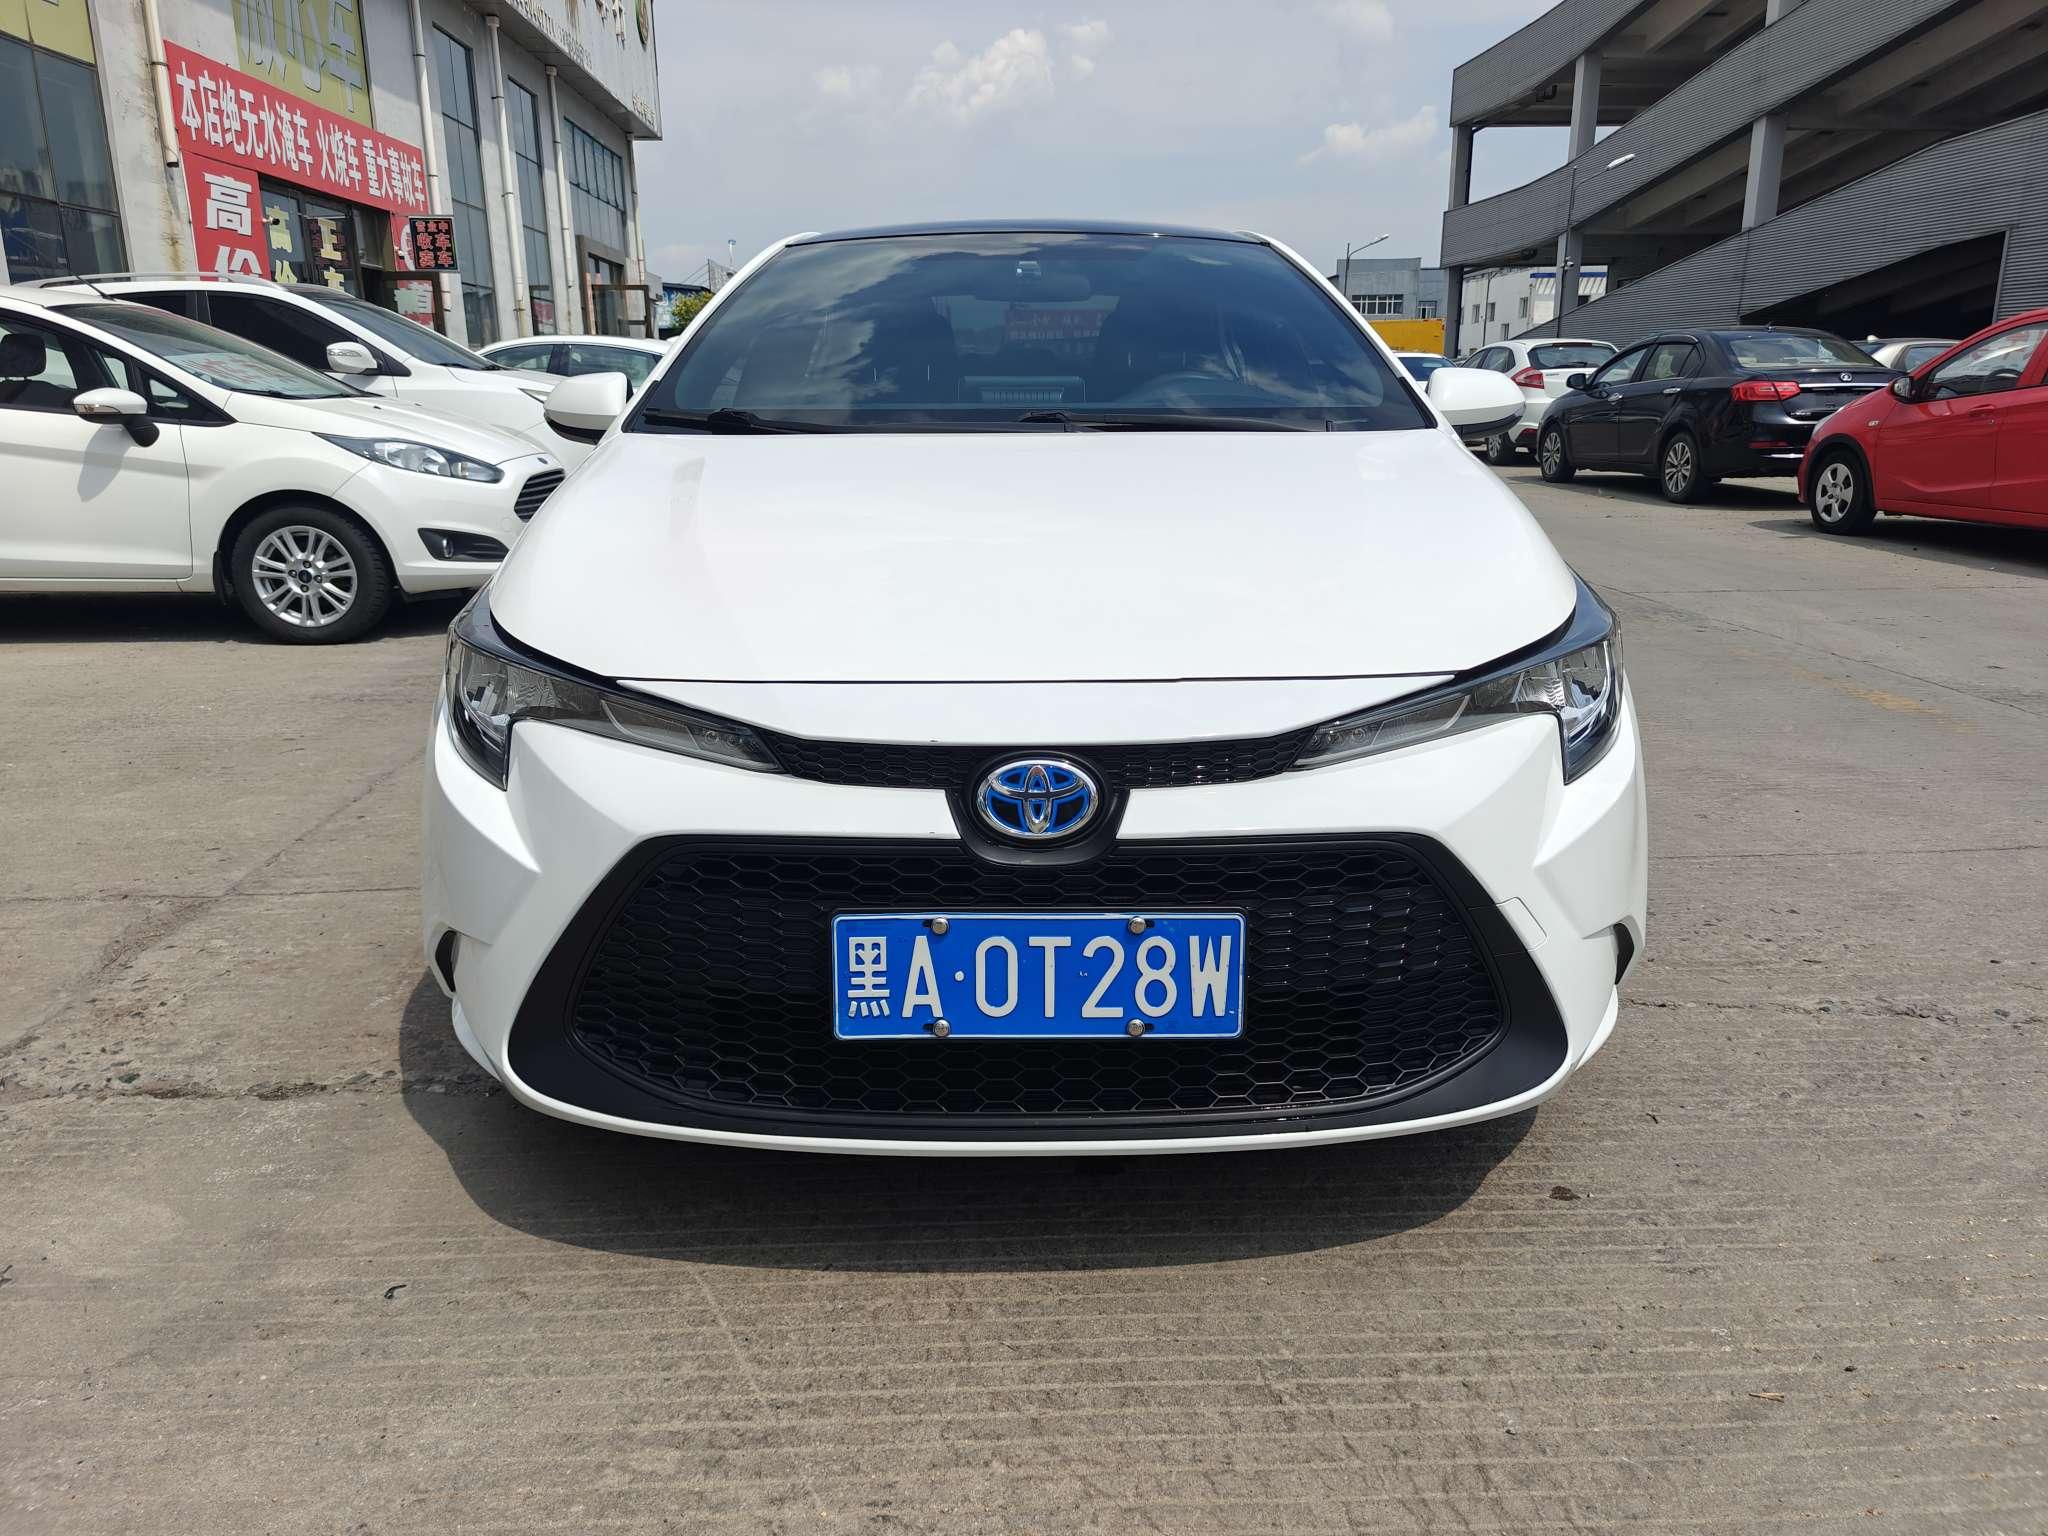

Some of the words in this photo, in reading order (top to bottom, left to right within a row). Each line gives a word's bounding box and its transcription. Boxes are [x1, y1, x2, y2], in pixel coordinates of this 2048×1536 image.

[176, 61, 313, 176] 本店绝无水淹车
[316, 119, 362, 192] 火烧车
[363, 139, 425, 211] 重大事故车
